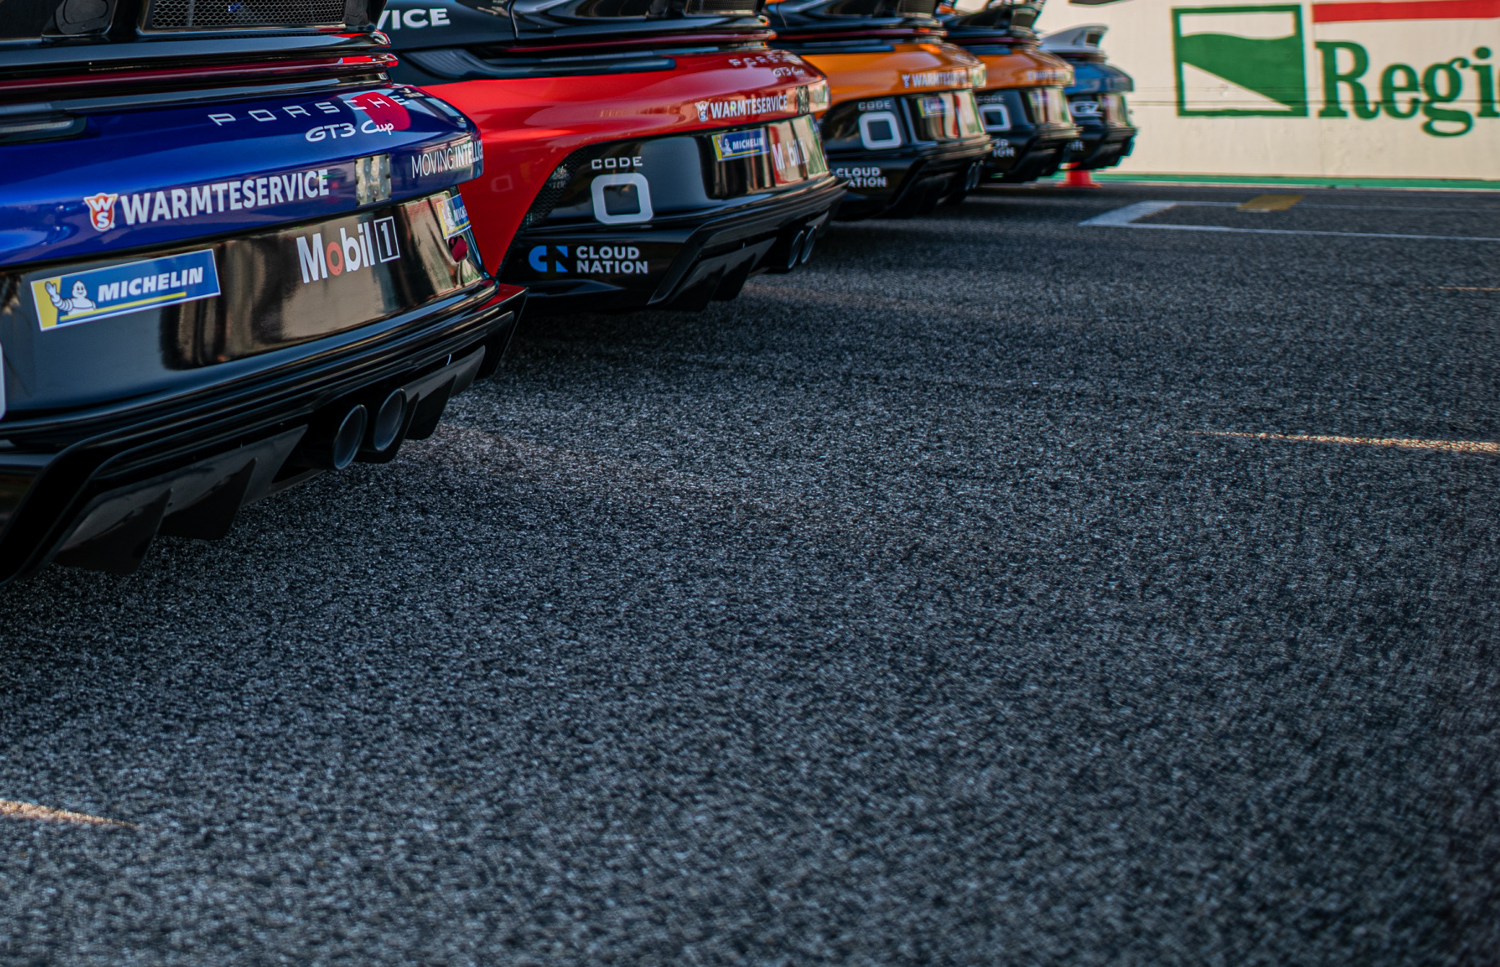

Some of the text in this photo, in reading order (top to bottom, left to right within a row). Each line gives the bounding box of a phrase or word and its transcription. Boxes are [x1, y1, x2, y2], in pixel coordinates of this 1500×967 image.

[208, 95, 410, 126] PORSCHE
[710, 95, 788, 119] WARMTESERVICE
[305, 120, 395, 143] GT3 Cup
[411, 148, 454, 179] MOVING
[591, 156, 643, 169] CODE
[836, 167, 880, 177] CLOUD
[848, 177, 887, 187] ATION
[120, 169, 329, 226] WARMTESERVICE
[296, 222, 375, 283] Mobil
[576, 246, 640, 259] CLOUD
[576, 260, 648, 274] NATION
[98, 266, 203, 302] MICHELIN
